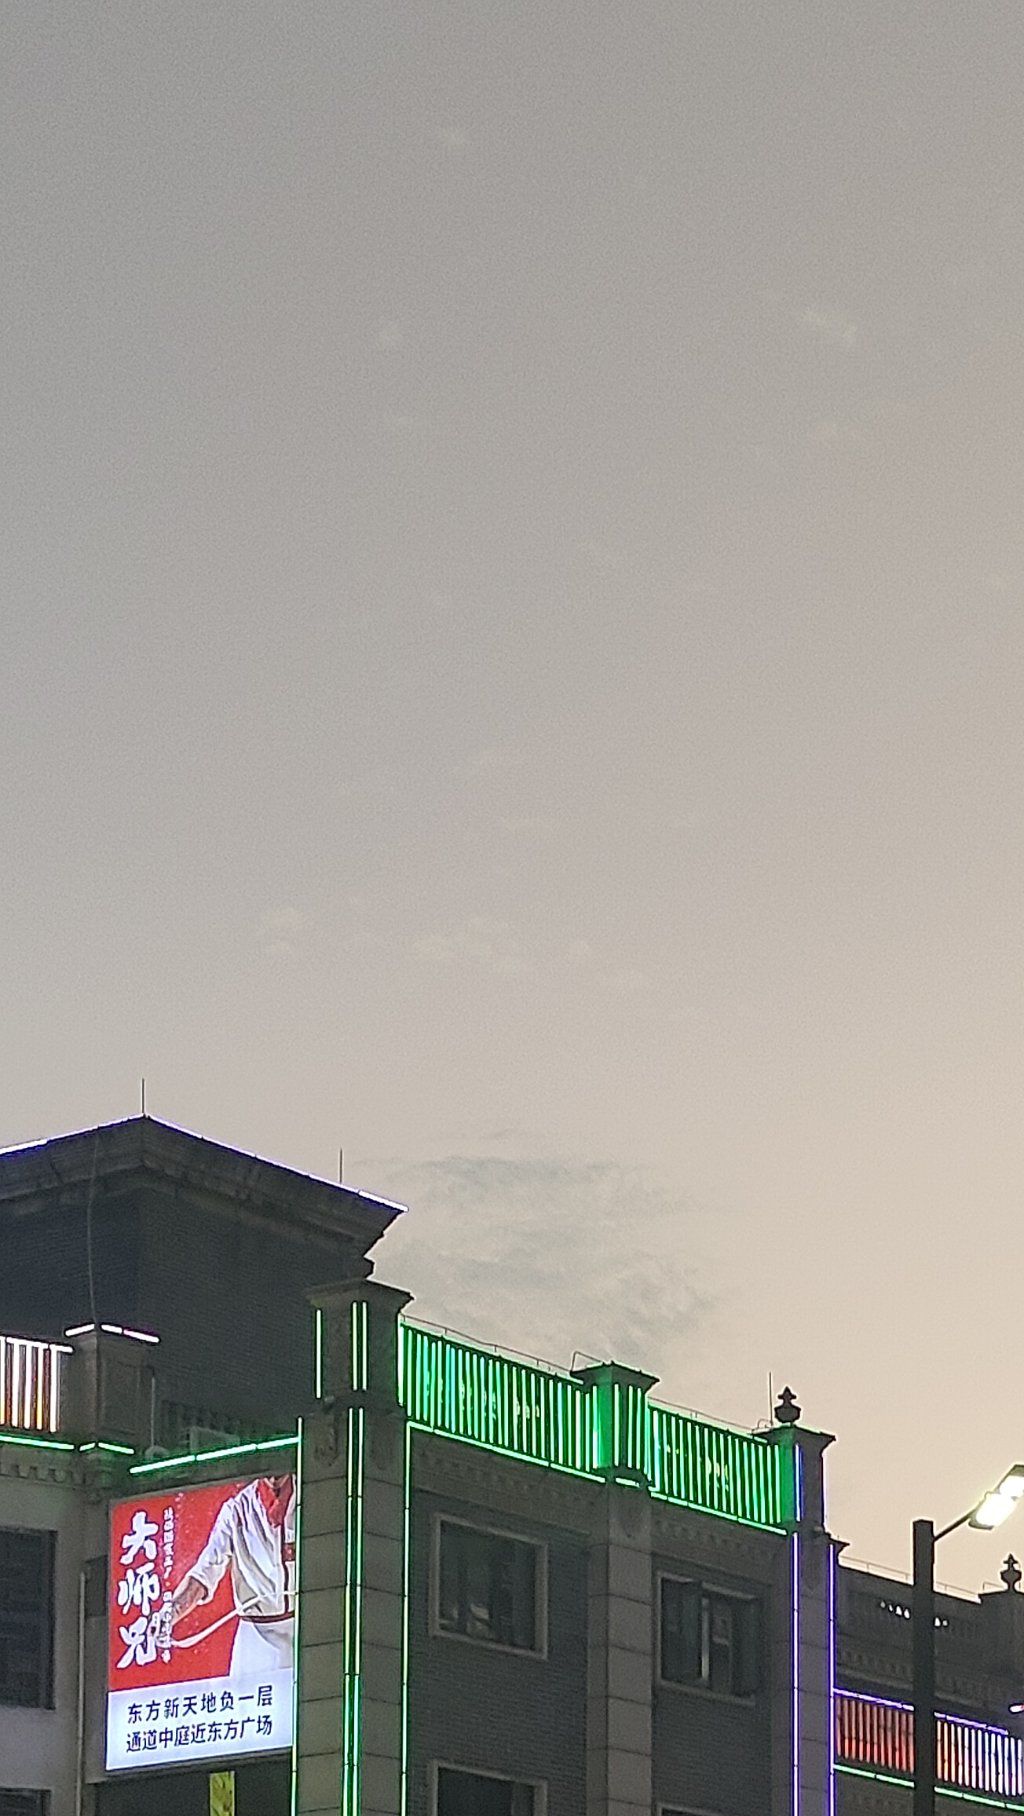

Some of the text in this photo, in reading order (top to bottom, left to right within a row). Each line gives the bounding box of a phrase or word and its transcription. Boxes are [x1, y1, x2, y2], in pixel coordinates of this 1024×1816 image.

[117, 1511, 161, 1669] 大师兄
[127, 1685, 274, 1724] 东方新天地负一层
[126, 1715, 273, 1753] 通道中庭近东方广场
